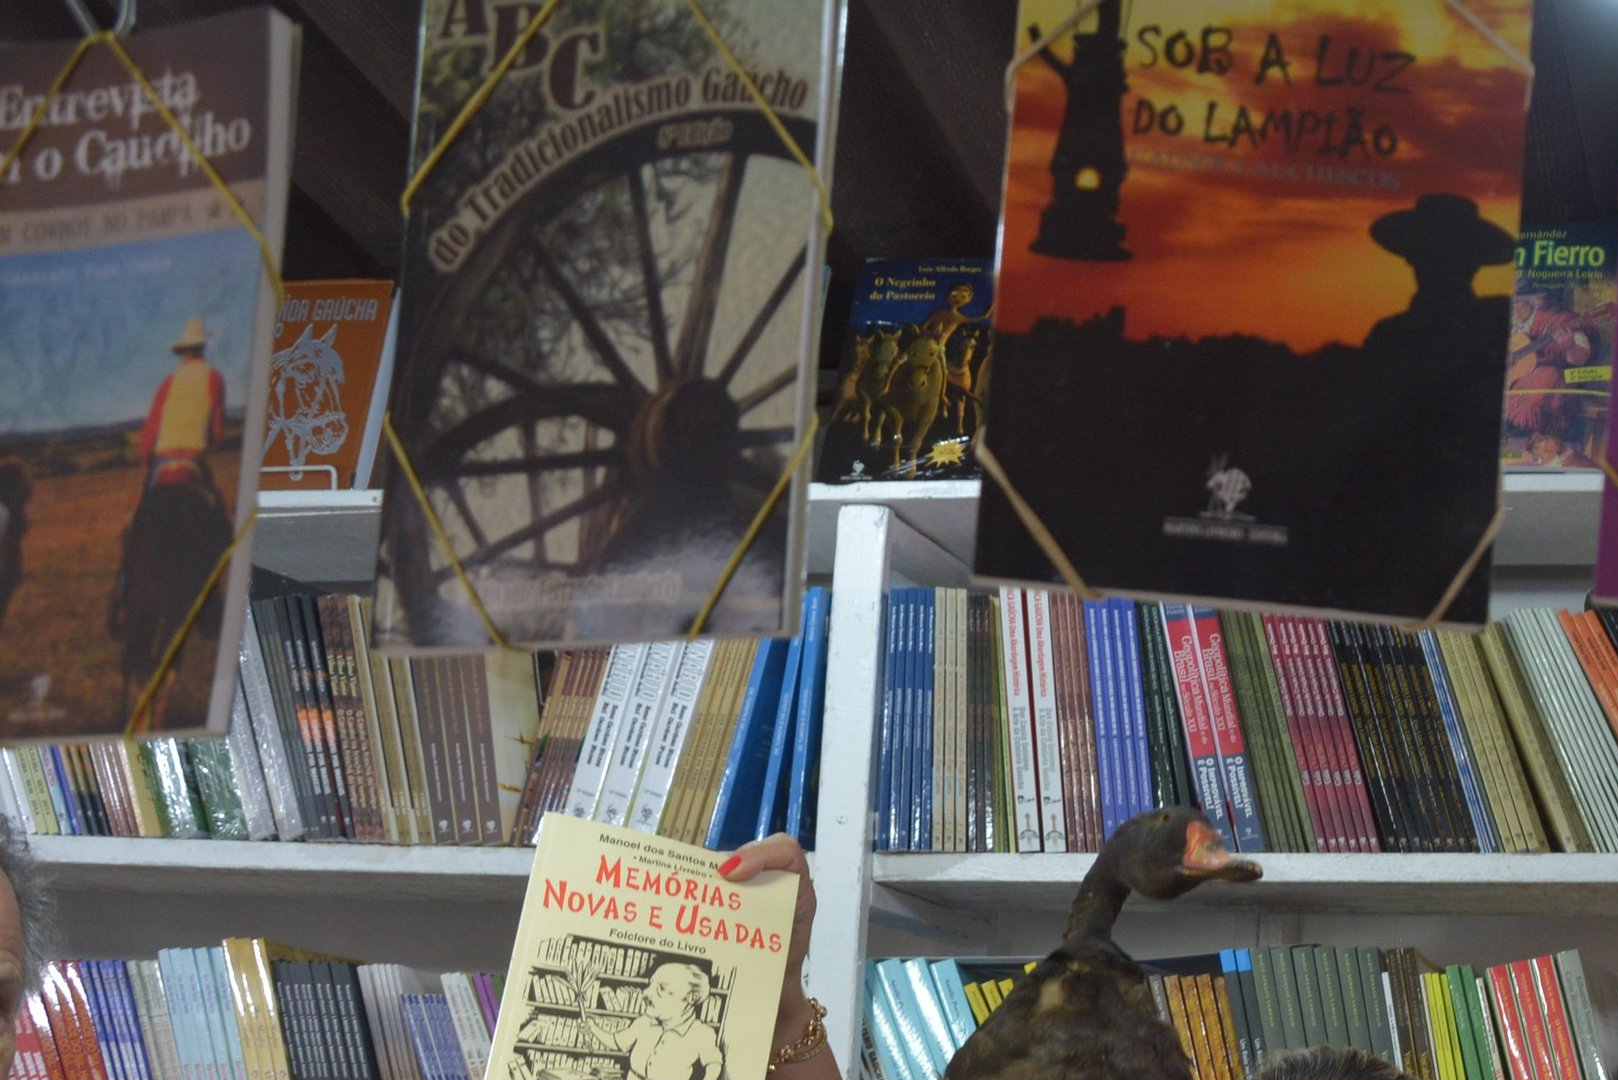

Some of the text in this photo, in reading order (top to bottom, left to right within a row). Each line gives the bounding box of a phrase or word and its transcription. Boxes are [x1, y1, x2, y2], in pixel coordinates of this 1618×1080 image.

[1138, 25, 1416, 94] SOB A LUZ
[1132, 99, 1397, 159] DO LAMPIÃO
[434, 221, 470, 268] do
[467, 77, 692, 232] Tradicionalismo
[1533, 240, 1605, 267] Fierro
[869, 290, 936, 301] do Pastoreio
[886, 276, 936, 289] Negrinho
[313, 296, 378, 321] GAÚCHA
[1173, 650, 1188, 683] Brasil
[1202, 648, 1217, 681] Brasil
[600, 834, 640, 850] Manoel
[644, 846, 664, 856] dos
[667, 849, 706, 866] Santos
[596, 854, 742, 911] MEMÓRIAS
[638, 857, 671, 869] Martins
[674, 865, 707, 878] Livreiro
[543, 879, 782, 953] NOVAS E USADAS
[609, 928, 706, 954] Folclore do Livro
